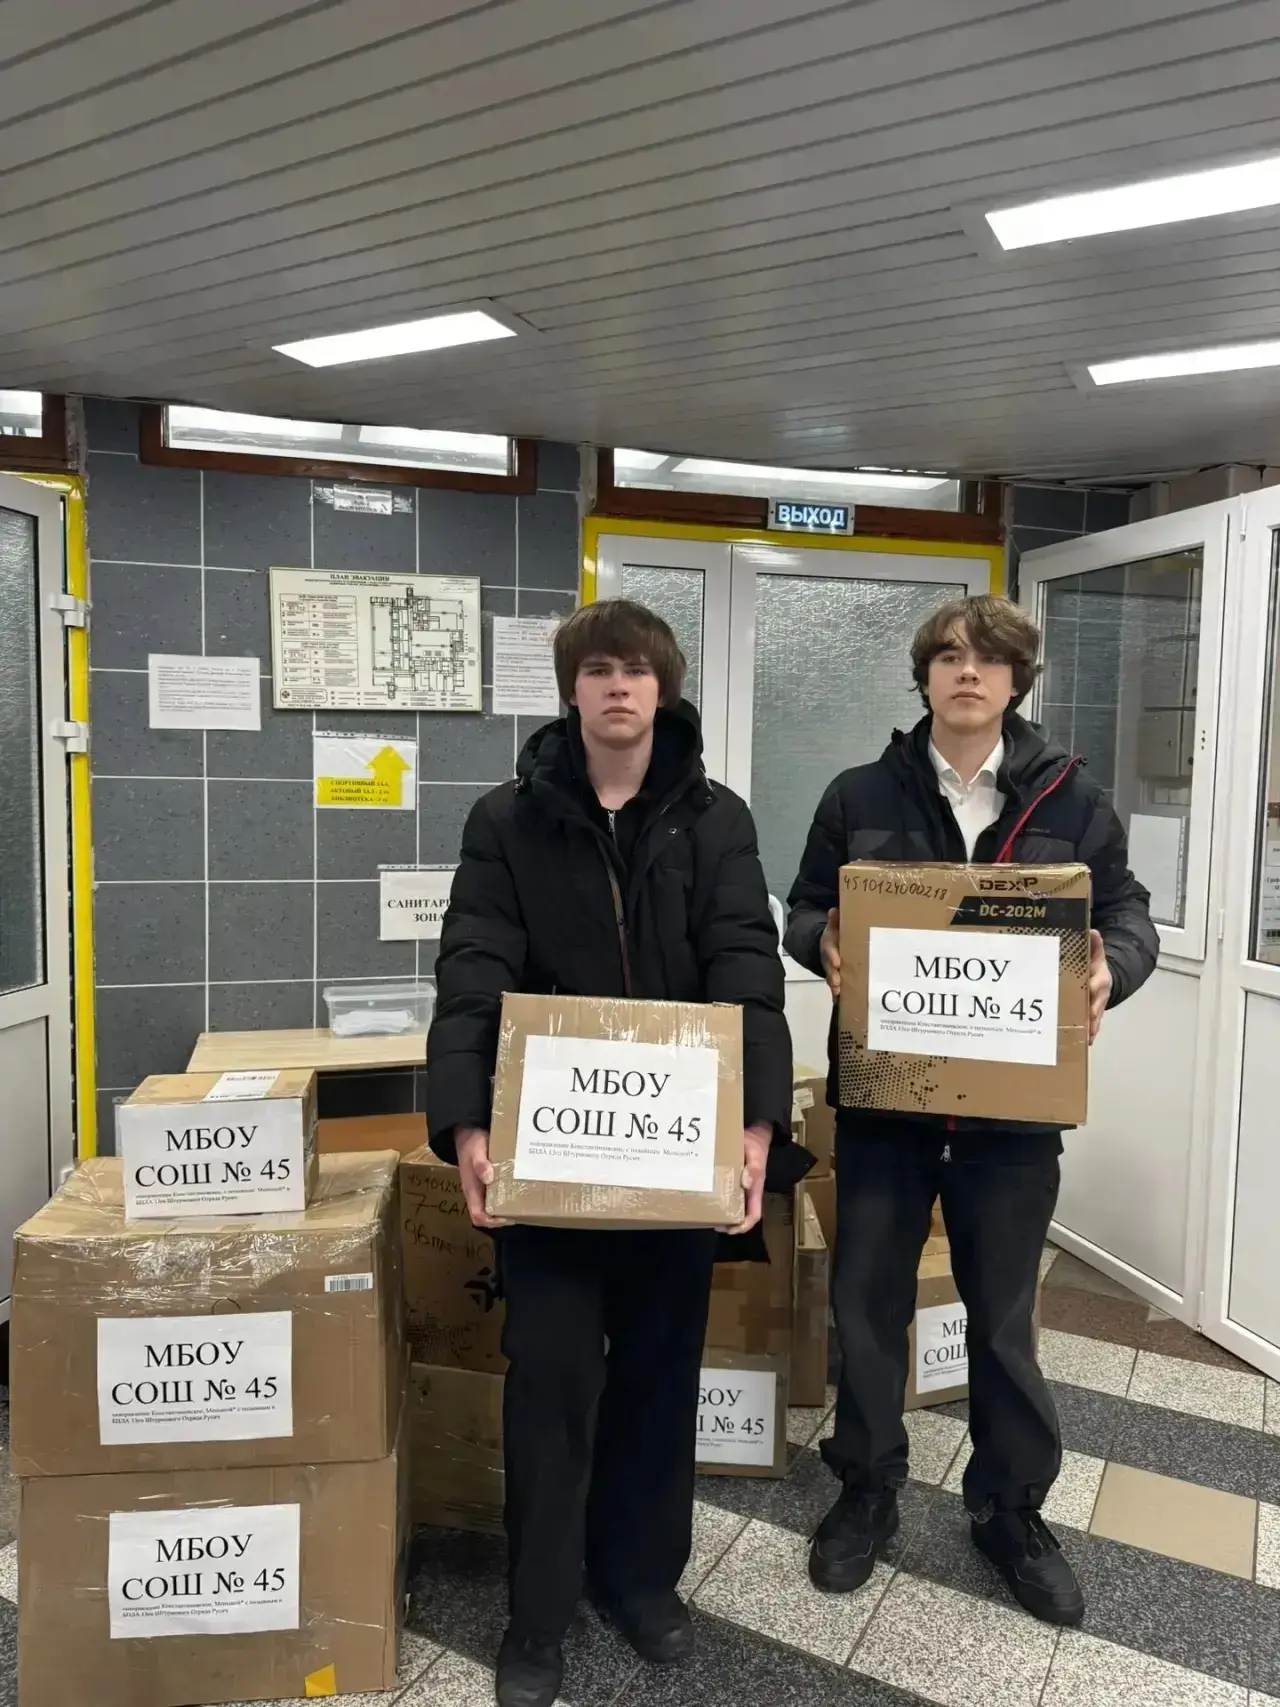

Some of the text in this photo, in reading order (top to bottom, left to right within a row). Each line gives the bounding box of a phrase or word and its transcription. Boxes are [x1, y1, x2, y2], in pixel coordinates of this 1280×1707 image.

[778, 504, 845, 527] ВЫХОД
[979, 877, 1038, 891] DEXP
[980, 904, 1046, 918] DC-202M
[914, 955, 1011, 982] МБОУ
[881, 989, 1043, 1022] СОШ № 45
[570, 1066, 671, 1098] МБОУ
[532, 1106, 701, 1143] СОШ № 45
[164, 1125, 258, 1152] МБОУ
[135, 1158, 290, 1188] СОШ № 45
[942, 1318, 968, 1338] МБ
[144, 1340, 244, 1368] МБОУ
[924, 1342, 968, 1366] СОШ
[112, 1376, 278, 1406] СОШ № 45
[698, 1388, 744, 1406] БОУ
[711, 1416, 735, 1434] №
[740, 1417, 764, 1436] 45
[156, 1534, 254, 1562] МБОУ
[122, 1568, 286, 1600] СОШ № 45
